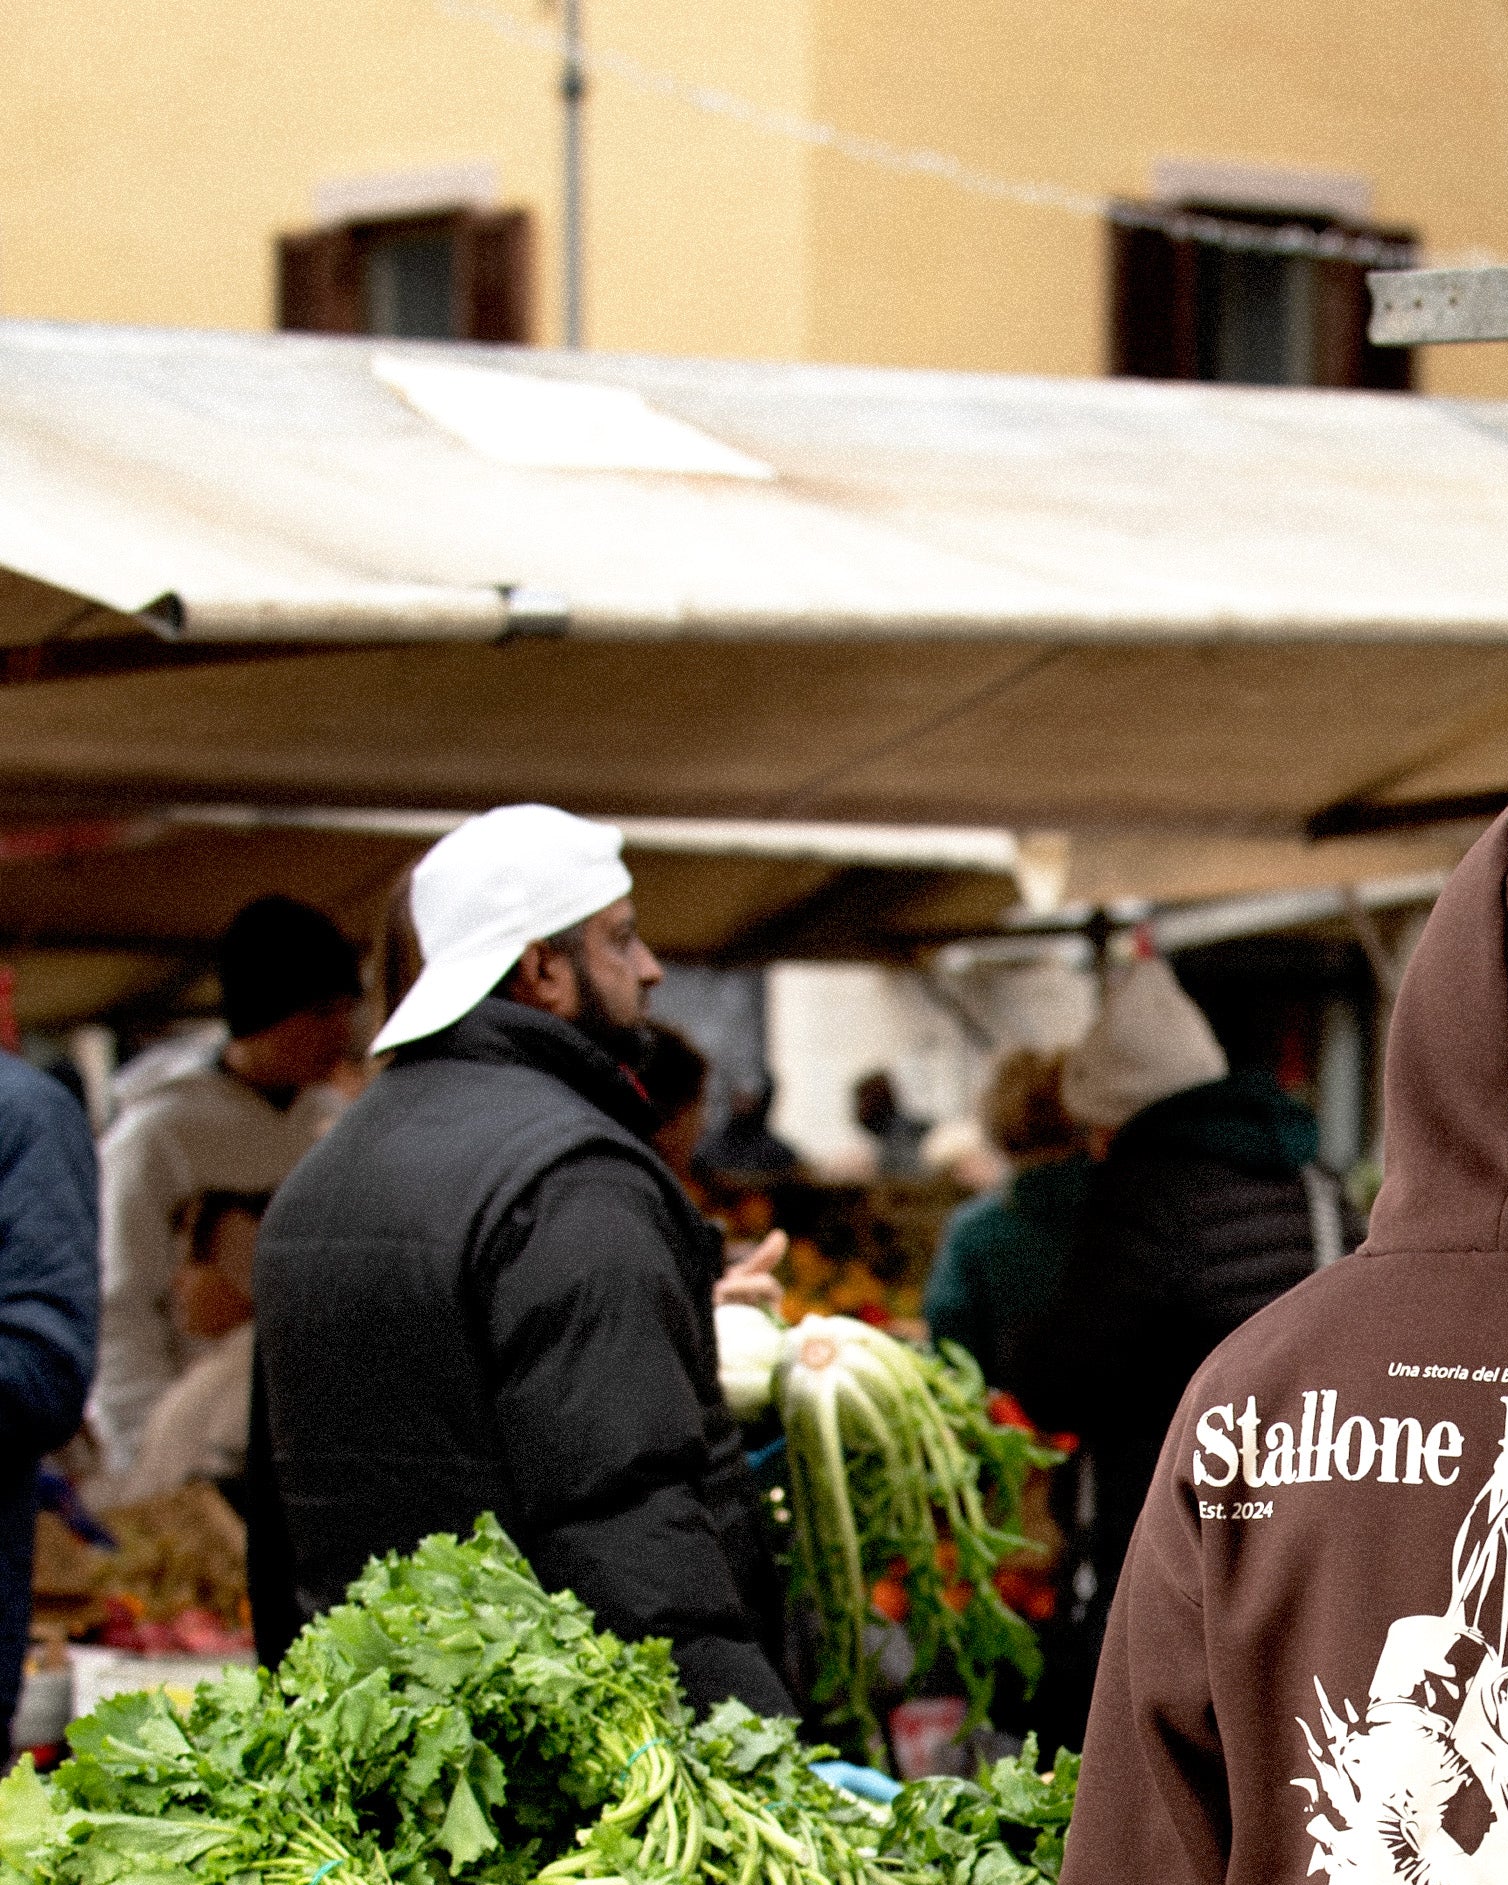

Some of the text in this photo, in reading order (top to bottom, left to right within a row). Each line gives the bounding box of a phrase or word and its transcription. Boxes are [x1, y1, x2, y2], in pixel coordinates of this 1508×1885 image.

[1388, 1362, 1421, 1379] Una
[1423, 1364, 1469, 1381] storia
[1472, 1366, 1500, 1383] del
[1193, 1389, 1465, 1488] Stallone
[1198, 1501, 1275, 1521] Est. 2024
